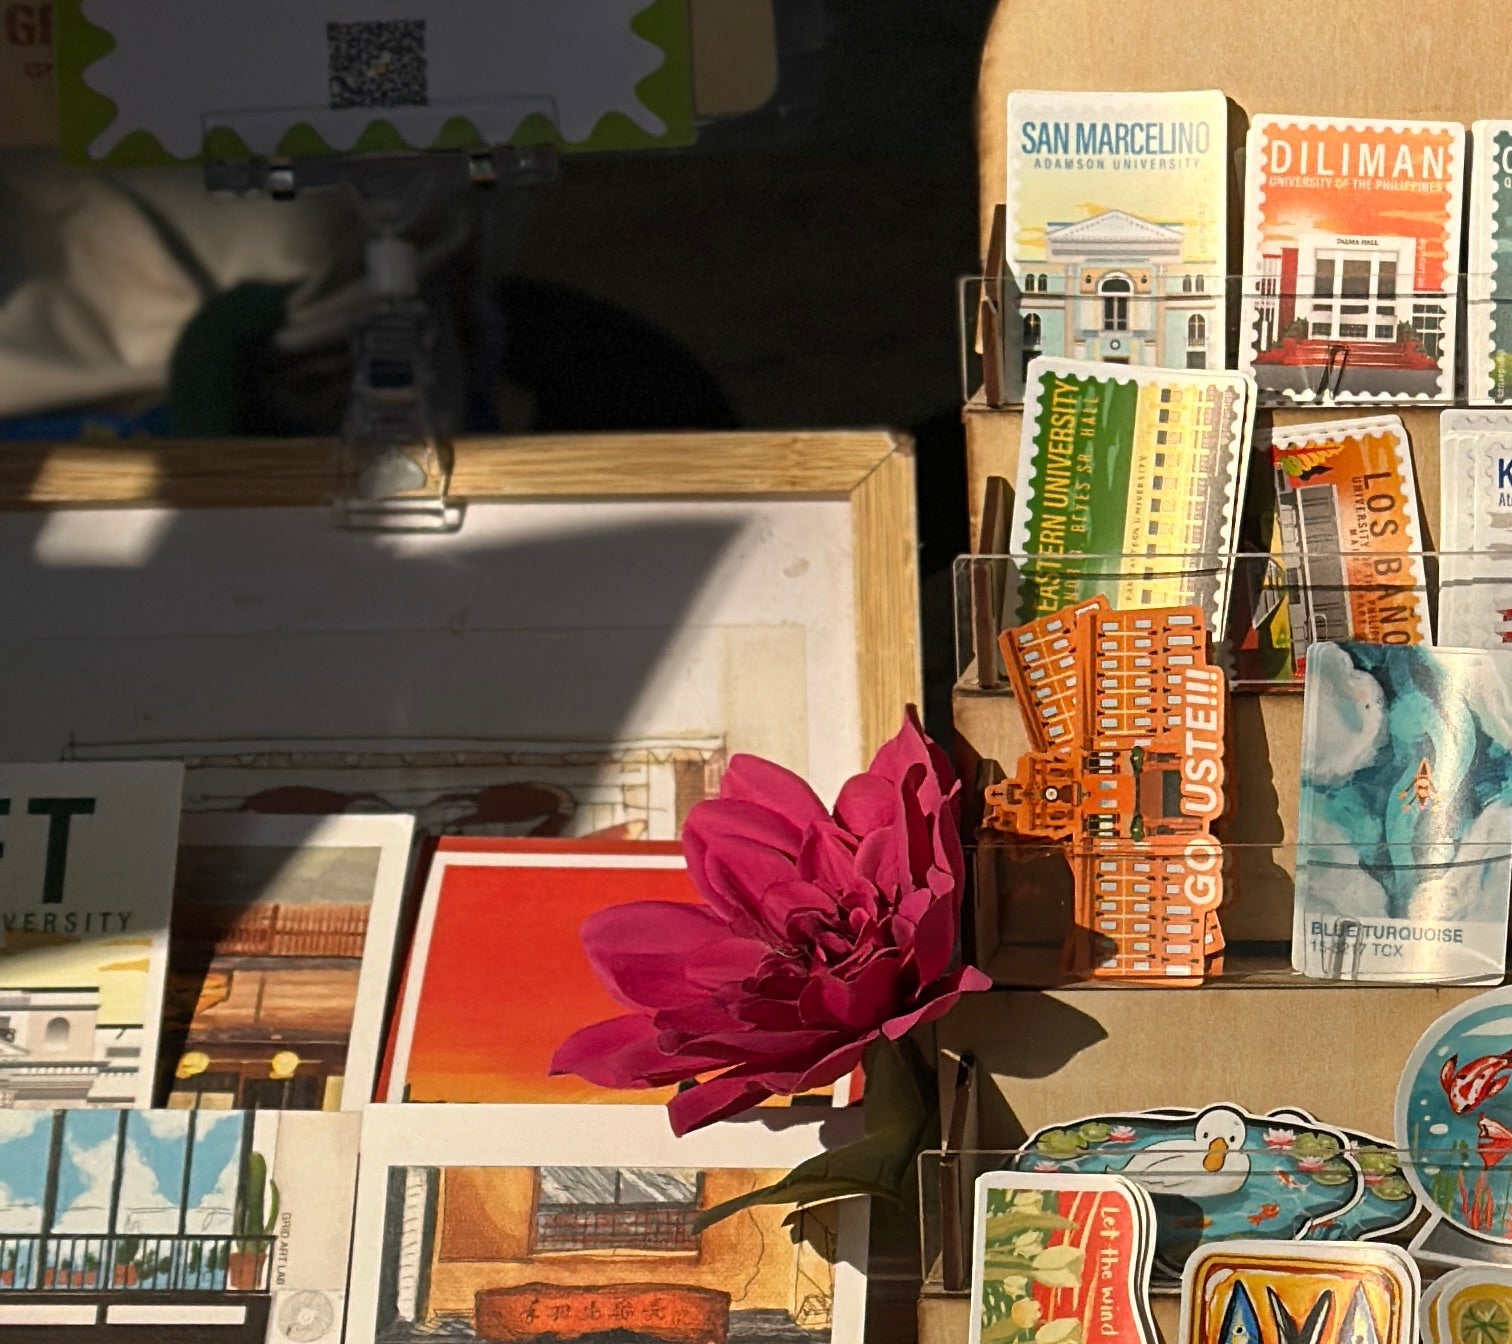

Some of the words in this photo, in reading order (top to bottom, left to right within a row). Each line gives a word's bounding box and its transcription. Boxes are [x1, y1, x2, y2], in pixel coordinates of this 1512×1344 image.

[1021, 122, 1069, 155] SAN
[1076, 122, 1210, 155] MARCELINO
[1034, 158, 1105, 170] ADAMSON
[1113, 158, 1200, 171] UNIVERSITY
[1270, 139, 1445, 180] DILIMAN
[1269, 176, 1333, 189] UNIVERSITY
[1335, 178, 1349, 189] OF
[1353, 179, 1373, 190] THE
[1375, 180, 1444, 193] PHILIPPINES
[1080, 395, 1099, 437] HALL
[1049, 379, 1081, 509] UNIVERSITY
[1351, 476, 1371, 548] UNIVERSITY
[1363, 472, 1399, 538] LOS
[1374, 557, 1415, 645] BAÑO
[1184, 668, 1219, 815] USTE!!!
[1183, 838, 1217, 905] GO
[1311, 920, 1359, 938] BLUE
[1363, 924, 1465, 944] TURQUOISE
[1372, 943, 1403, 957] TCX
[281, 1212, 292, 1239] GRID
[278, 1241, 289, 1263] ART
[1101, 1243, 1120, 1281] the
[1100, 1286, 1120, 1337] wind
